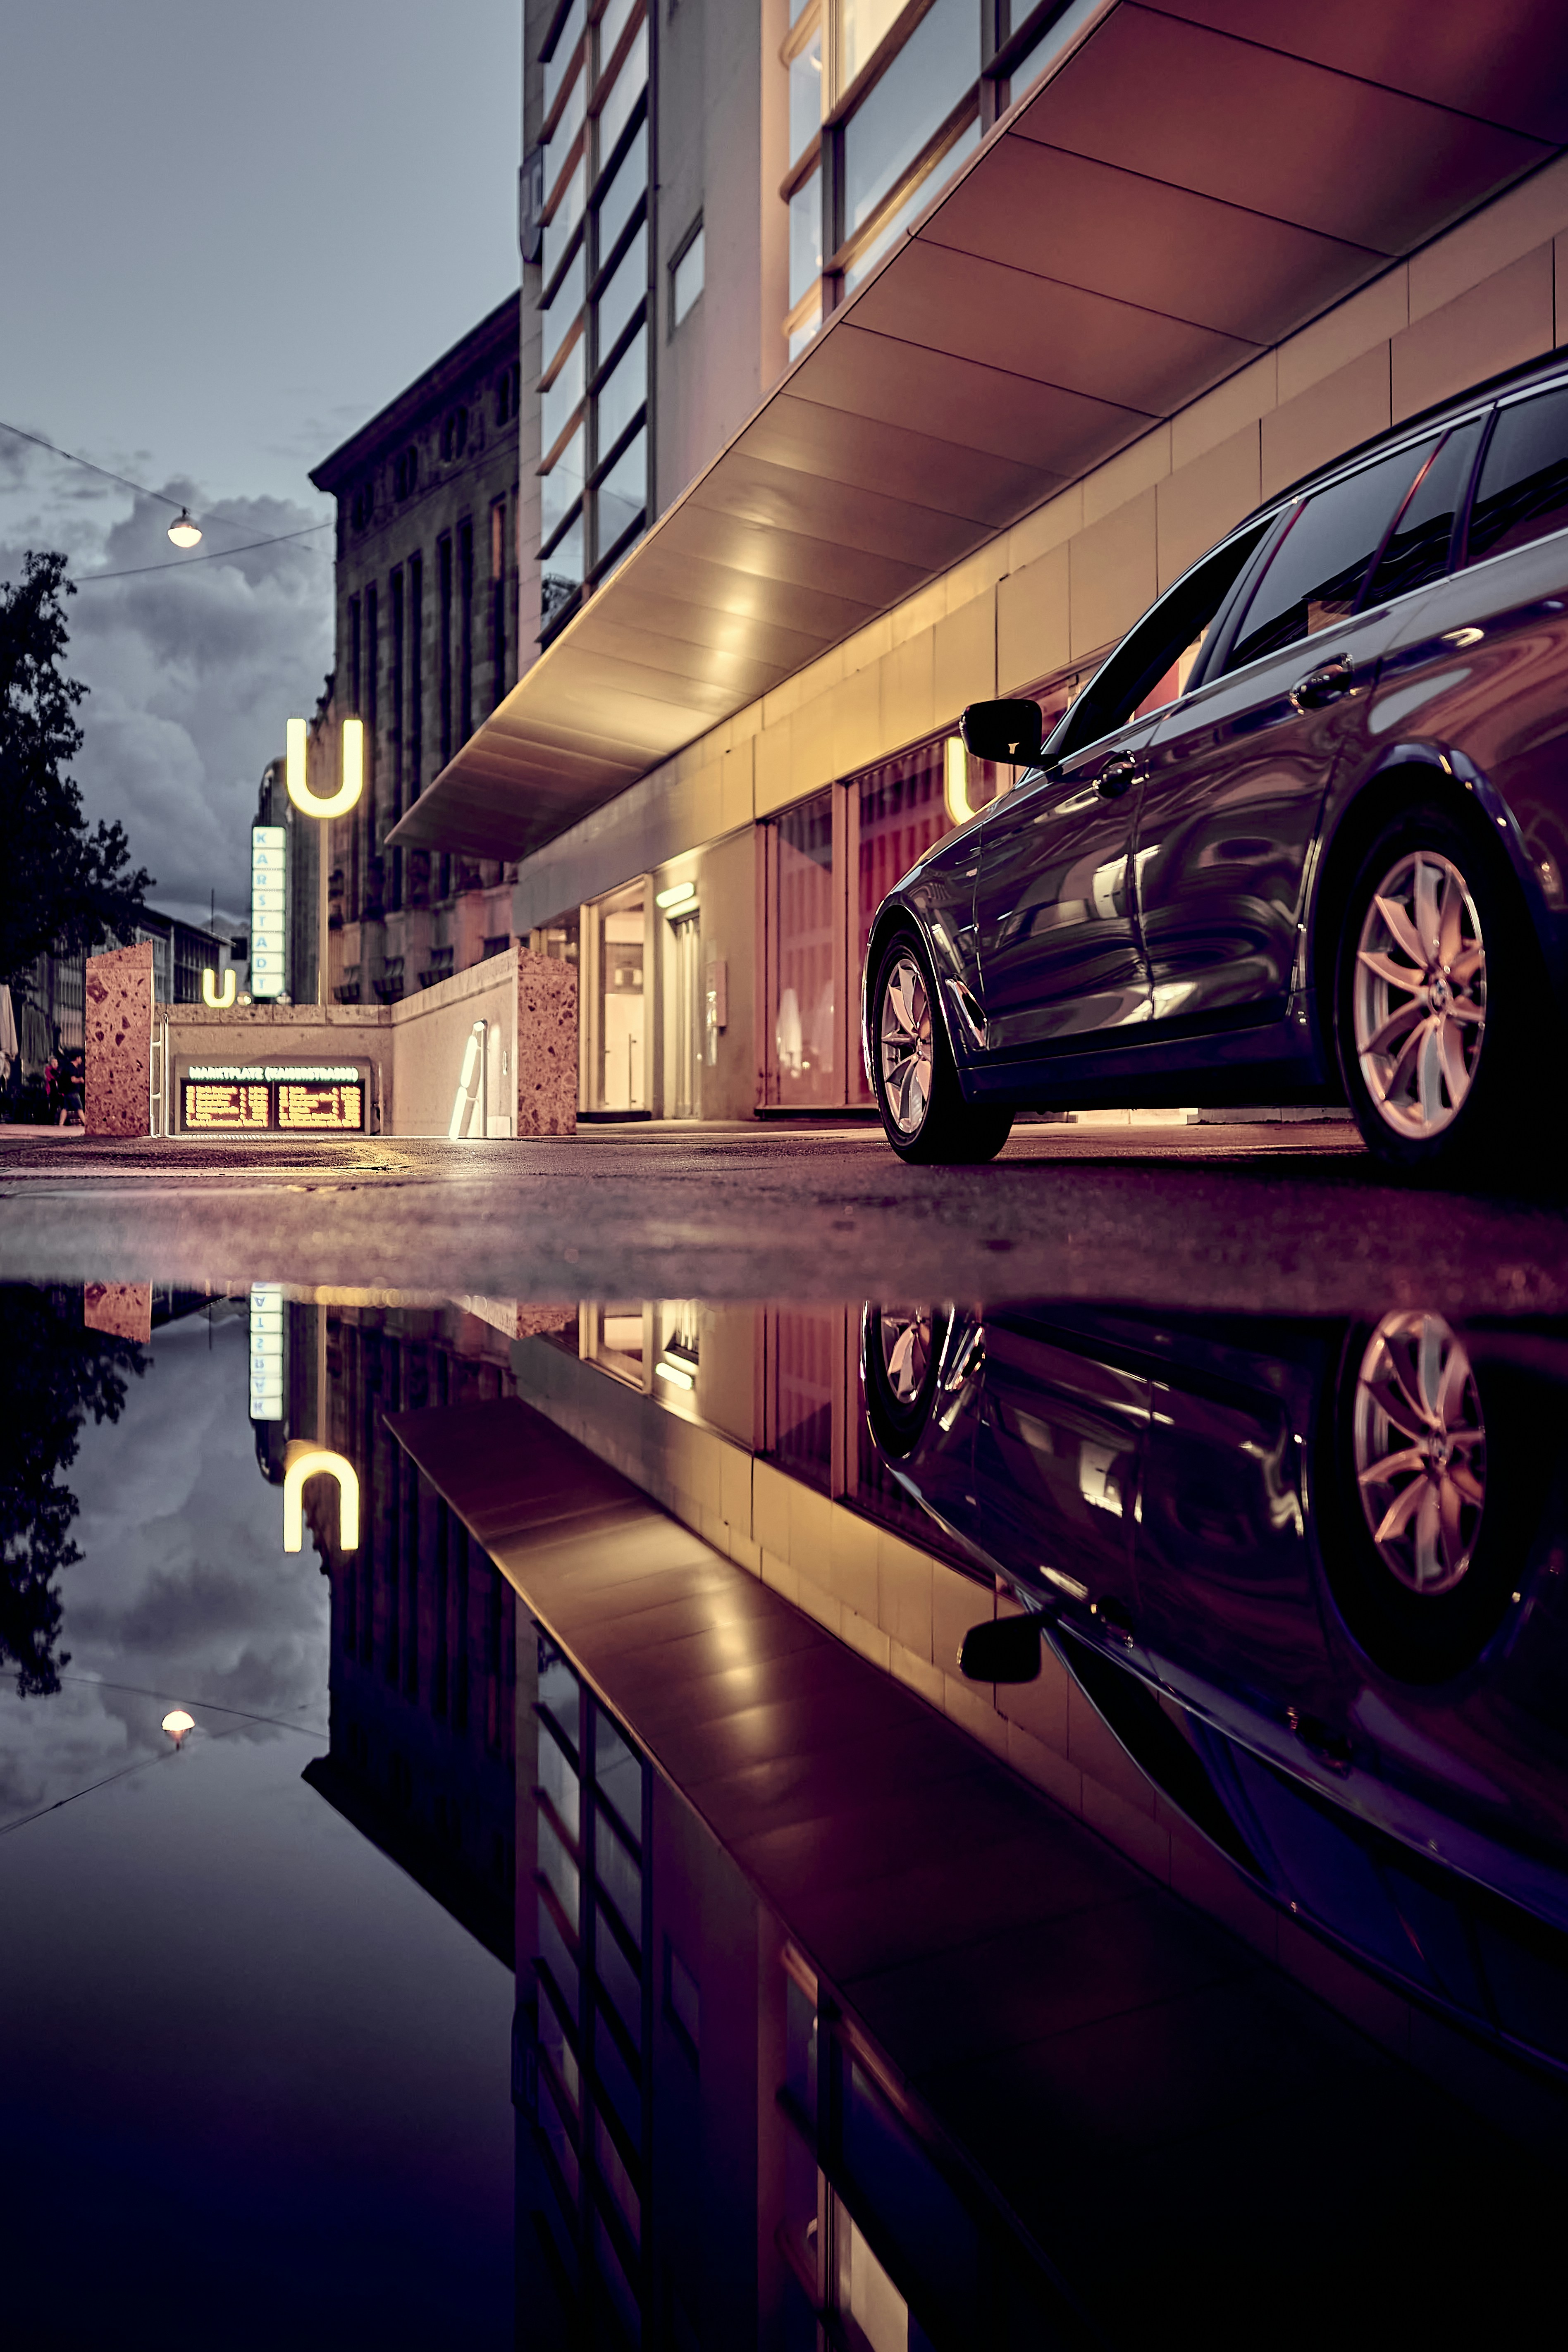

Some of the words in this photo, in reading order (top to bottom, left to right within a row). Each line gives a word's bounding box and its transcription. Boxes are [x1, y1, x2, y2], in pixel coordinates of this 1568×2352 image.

[286, 718, 363, 818] U
[255, 832, 268, 990] KARSTADT
[203, 968, 236, 1008] U
[189, 1066, 264, 1080] MARKTPLATZ
